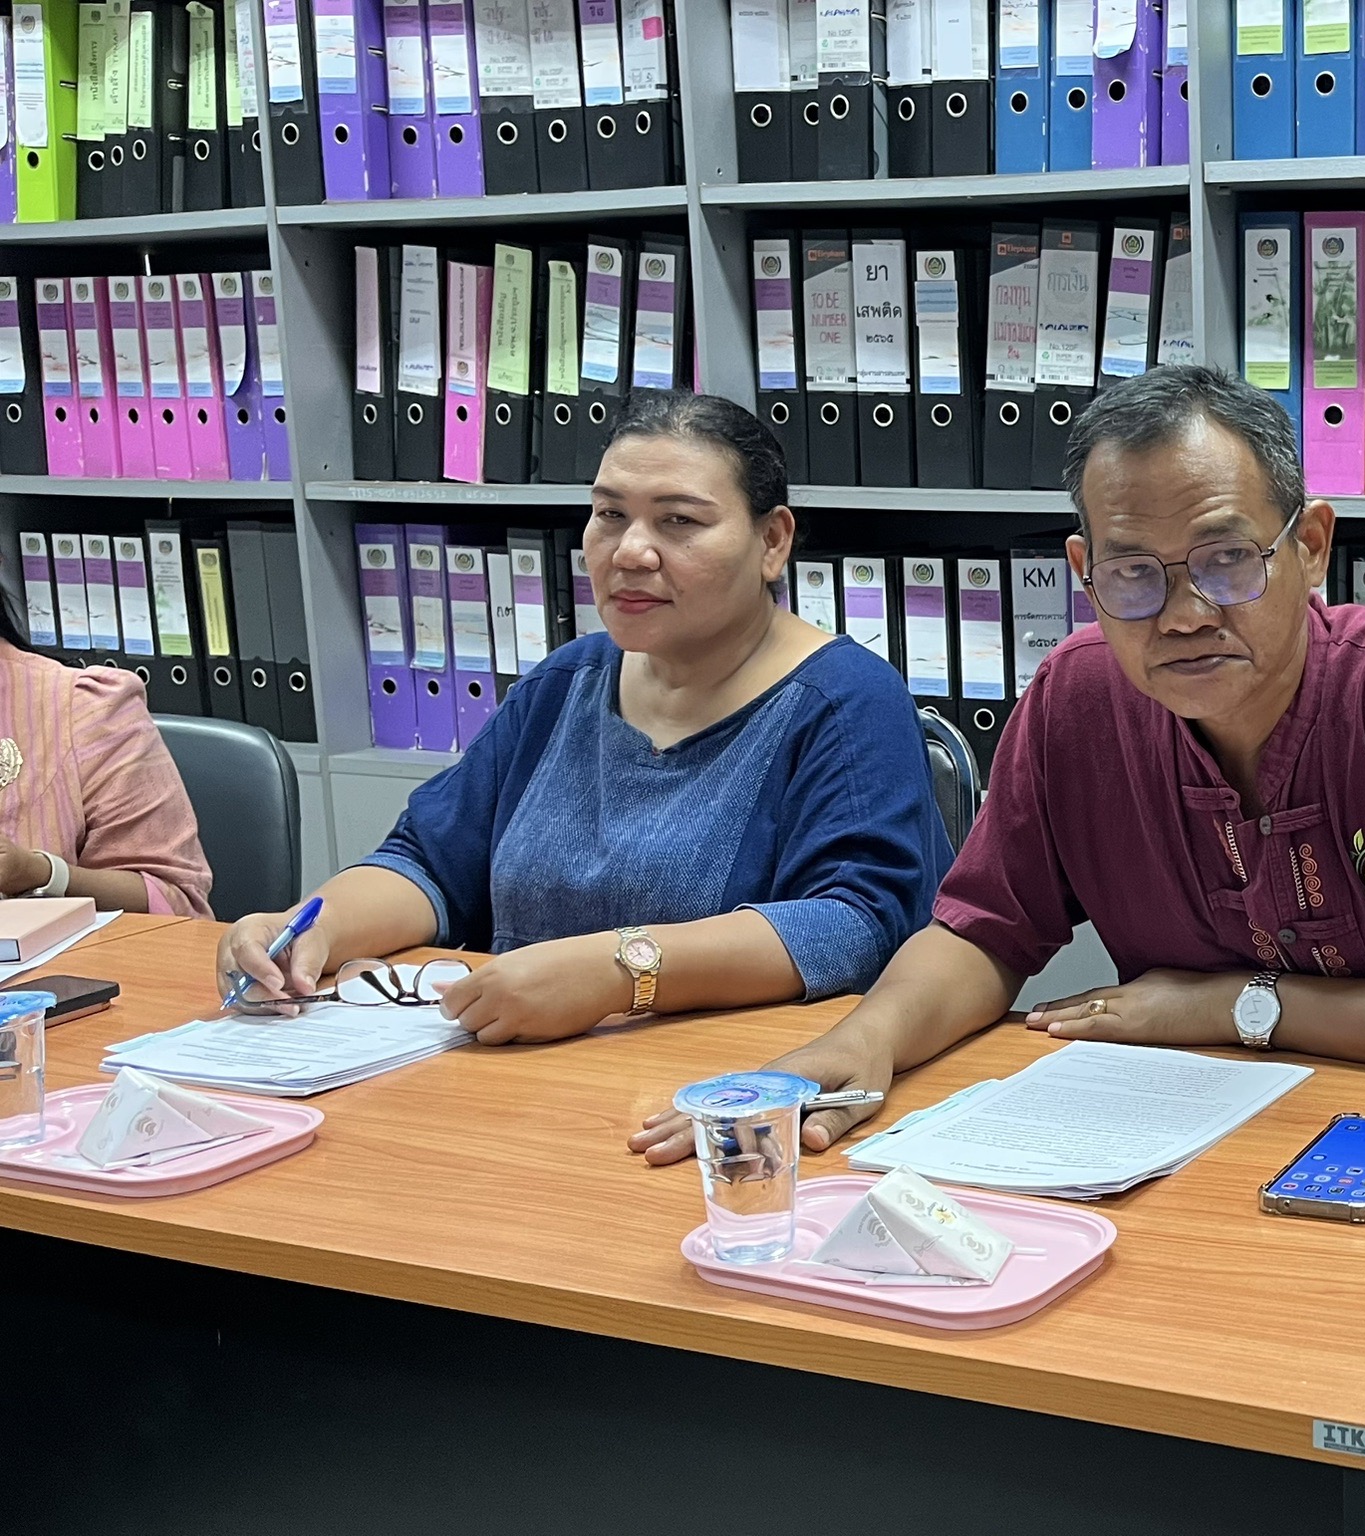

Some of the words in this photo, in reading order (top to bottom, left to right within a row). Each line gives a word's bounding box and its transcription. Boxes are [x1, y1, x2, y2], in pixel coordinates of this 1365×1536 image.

[866, 264, 888, 281] ยา
[1047, 269, 1089, 292] การเงิน
[811, 293, 823, 309] TO
[826, 292, 839, 309] BE
[856, 301, 902, 318] เสพติด
[811, 314, 847, 327] NUMBER
[820, 332, 841, 344] ONE
[866, 334, 894, 344] ๒๕๖๕
[1023, 567, 1056, 588] KM
[1323, 1424, 1365, 1447] ITK
